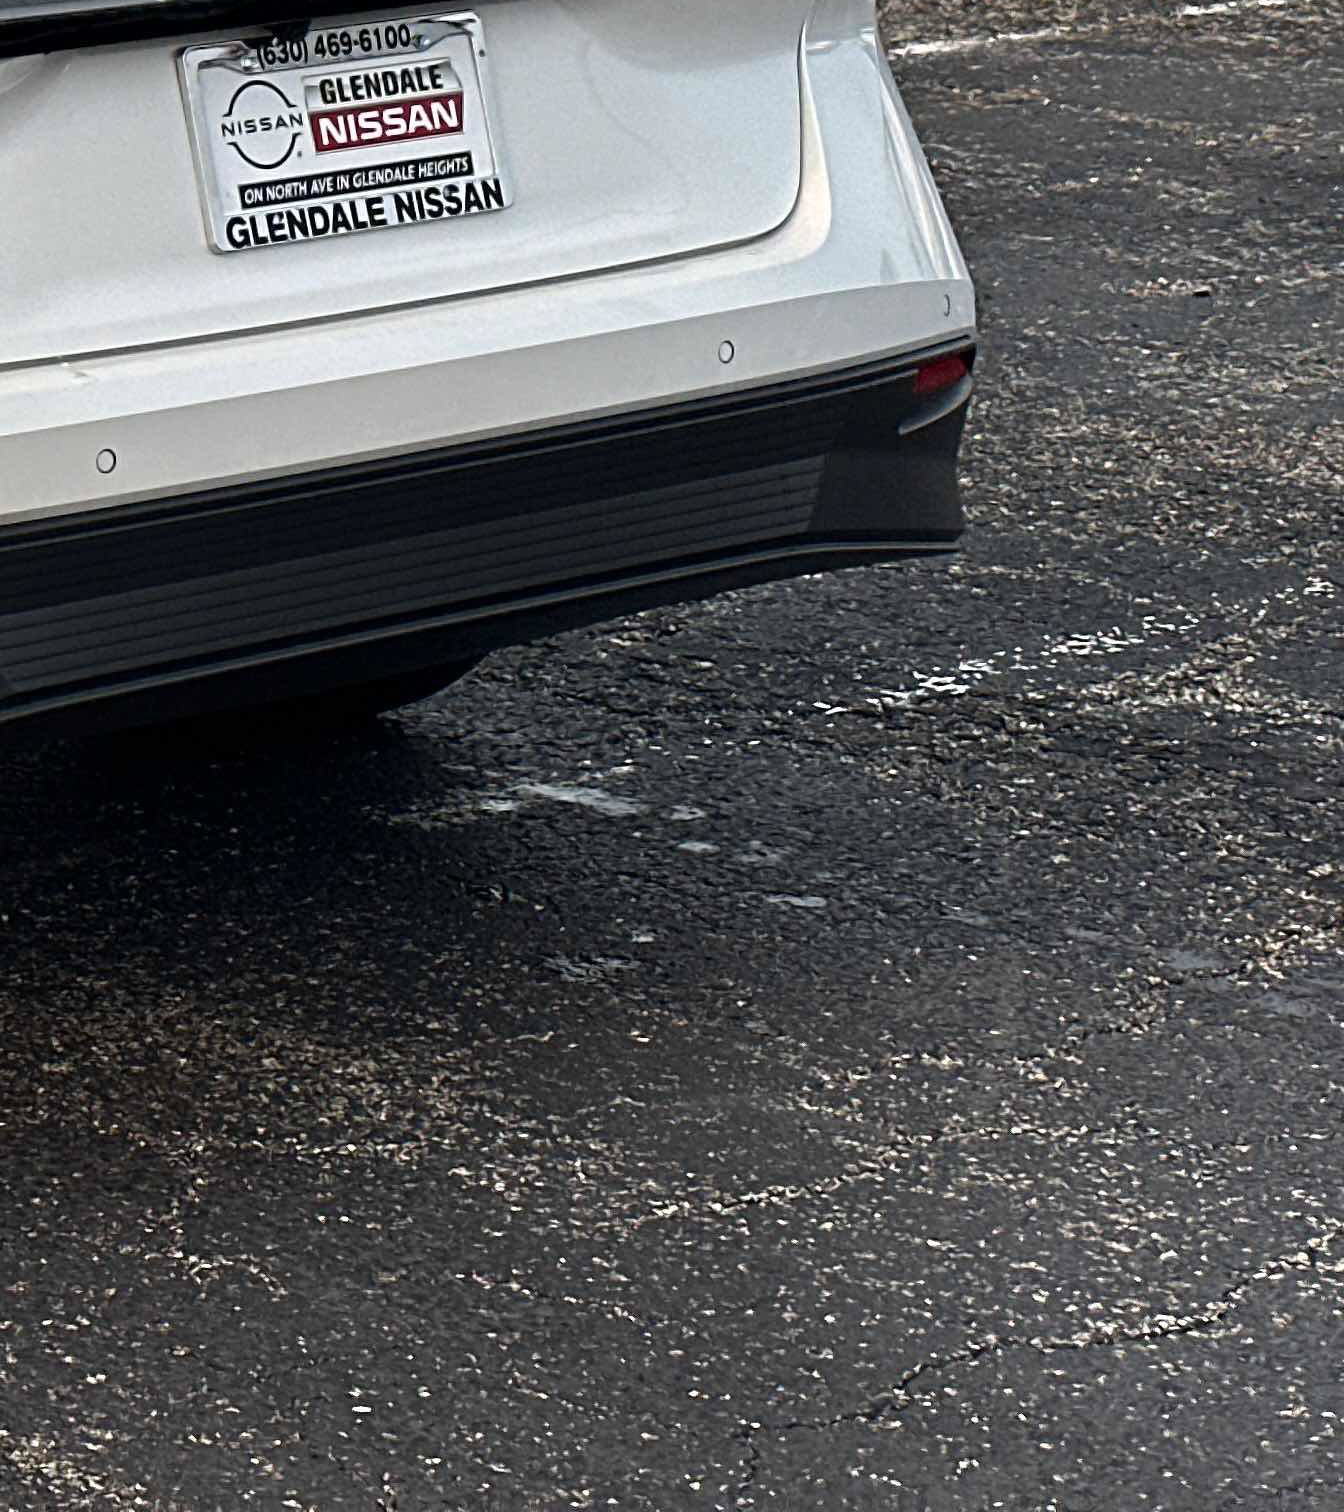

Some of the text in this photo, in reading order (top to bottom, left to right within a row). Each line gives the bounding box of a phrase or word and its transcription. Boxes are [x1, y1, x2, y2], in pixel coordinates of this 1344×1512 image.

[256, 23, 412, 67] (630) 469-6100
[320, 64, 444, 105] GLENDALE
[221, 112, 304, 138] NISSAN
[318, 99, 459, 147] NISSAN
[244, 156, 469, 205] ON NORTH AVE IN GLENDALE HEIGHTS
[225, 178, 505, 250] GLENDALE NISSAN
